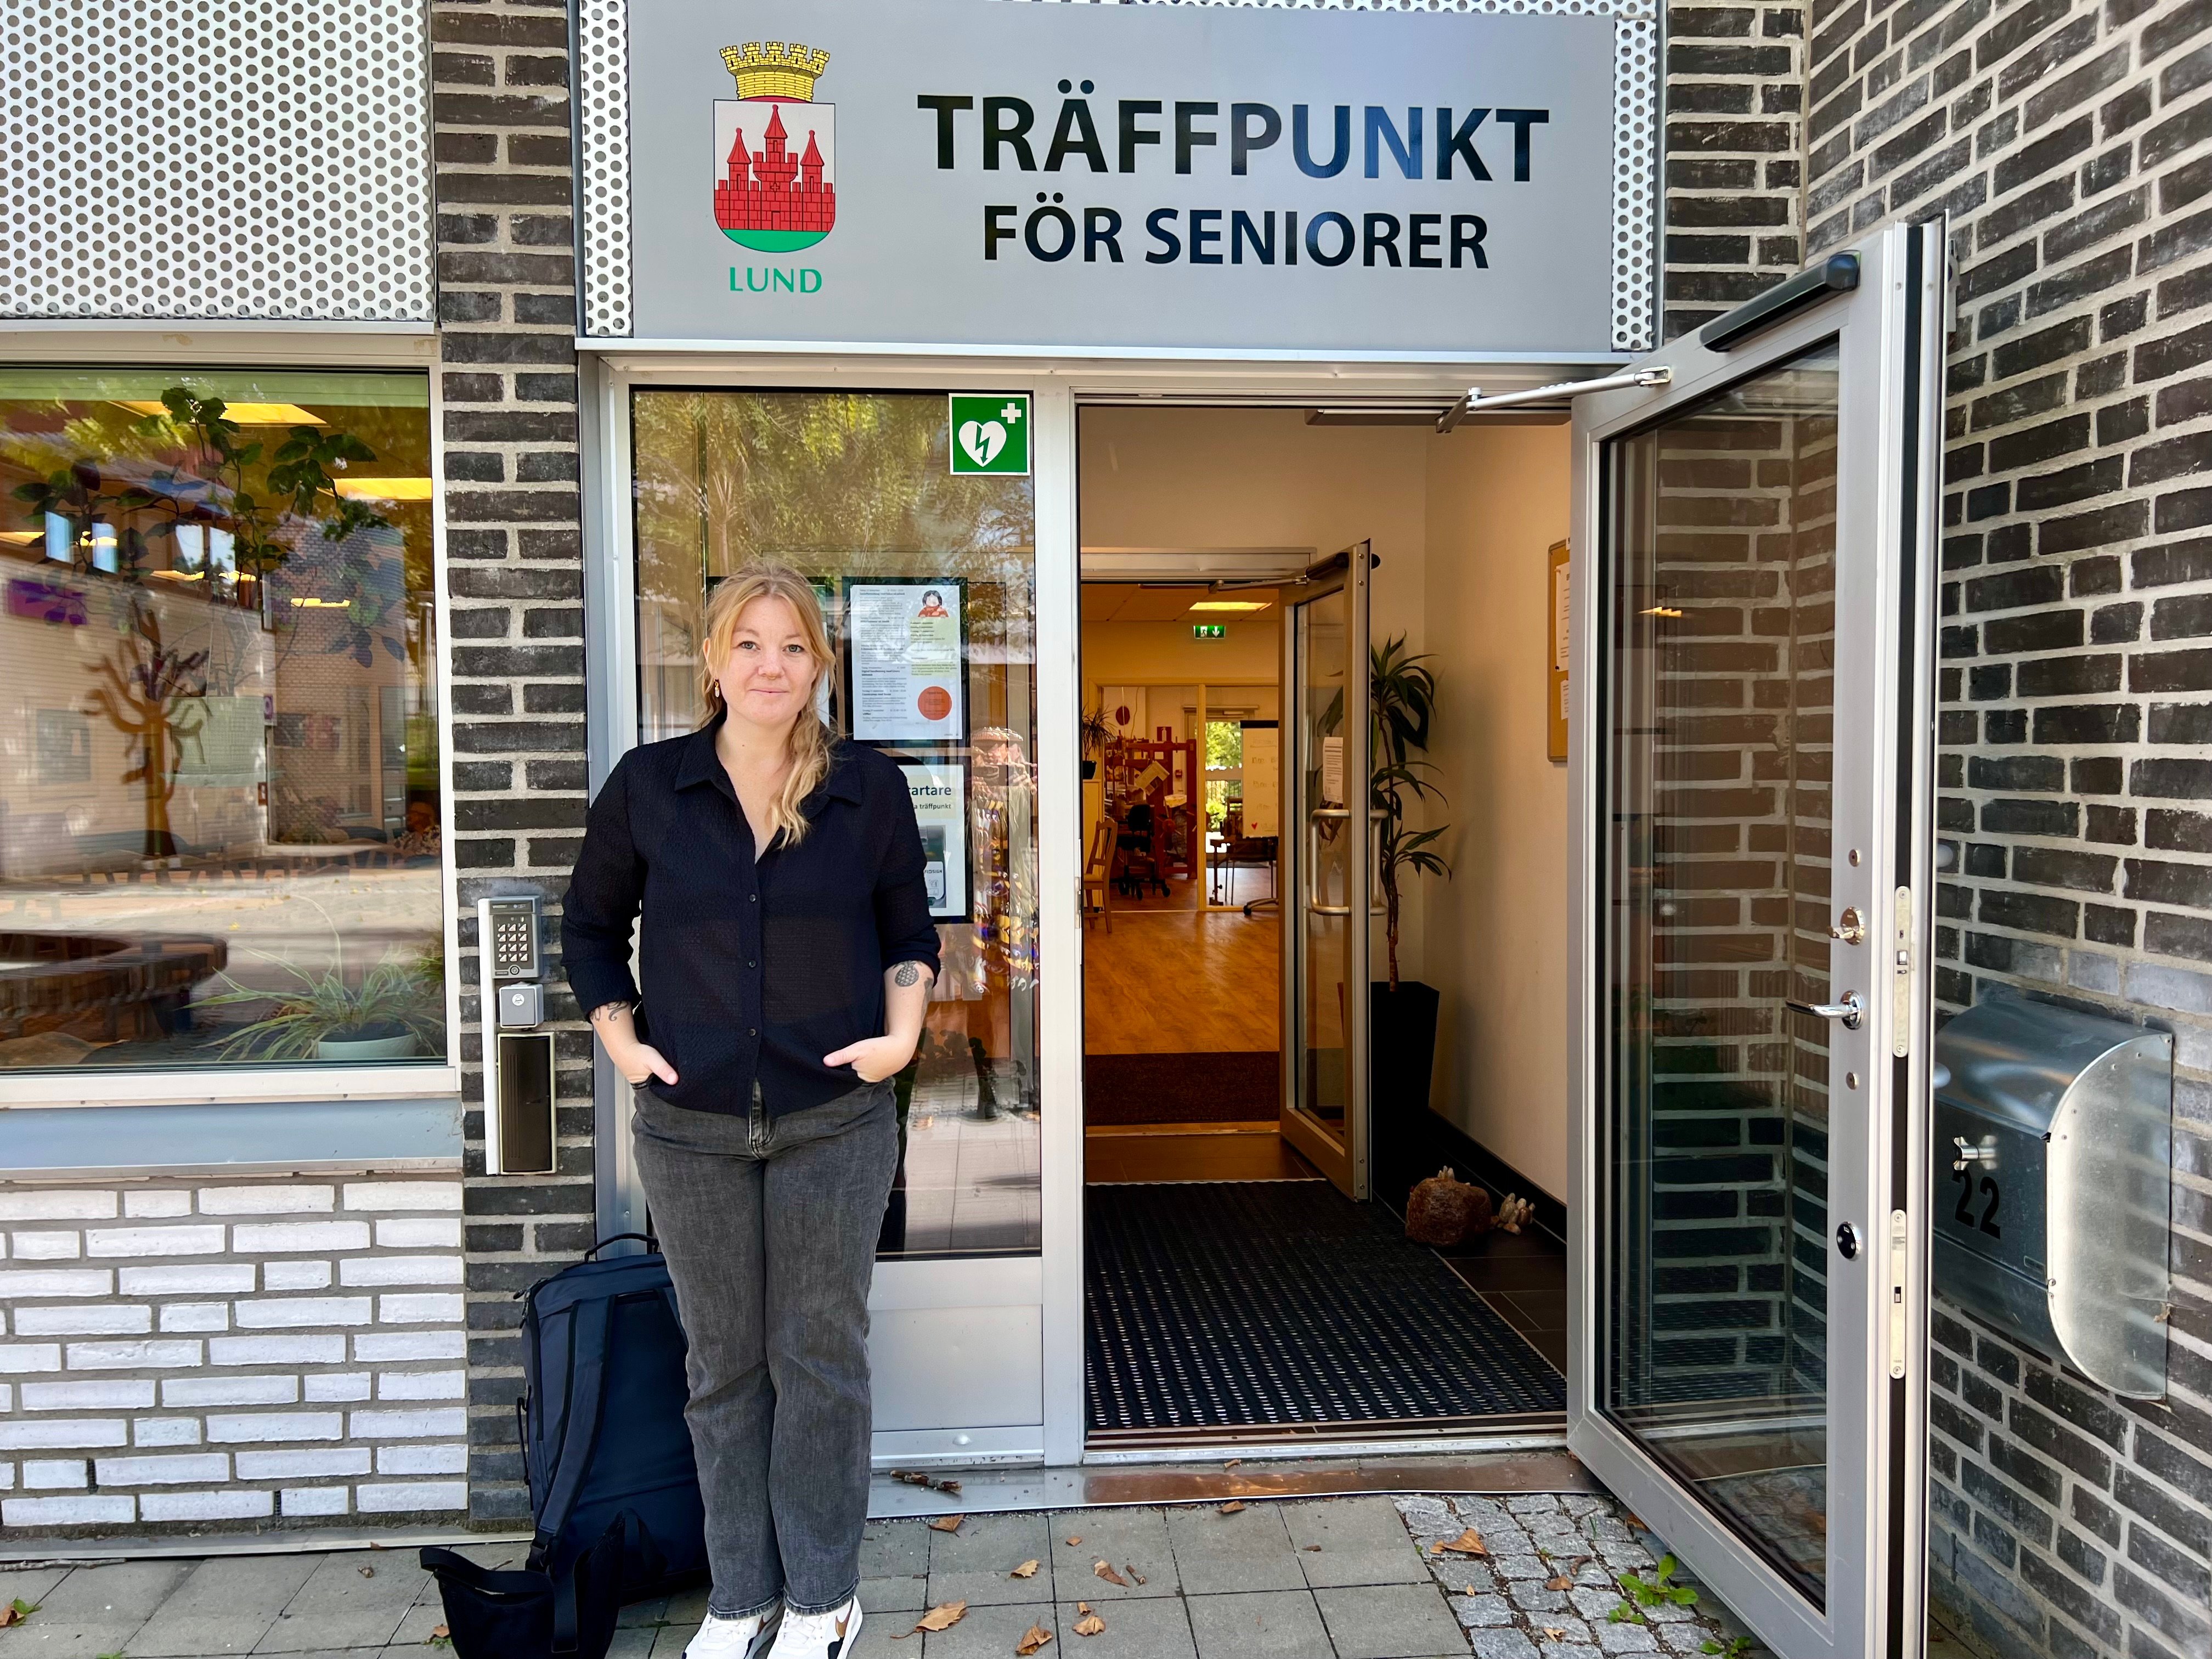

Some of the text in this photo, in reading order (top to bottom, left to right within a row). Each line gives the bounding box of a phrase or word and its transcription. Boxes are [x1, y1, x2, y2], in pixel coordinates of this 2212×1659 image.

[918, 79, 1549, 182] TRÄFFPUNKT
[985, 192, 1489, 269] FÖR SENIORER
[729, 266, 823, 294] LUND
[1951, 1168, 2001, 1240] 22
